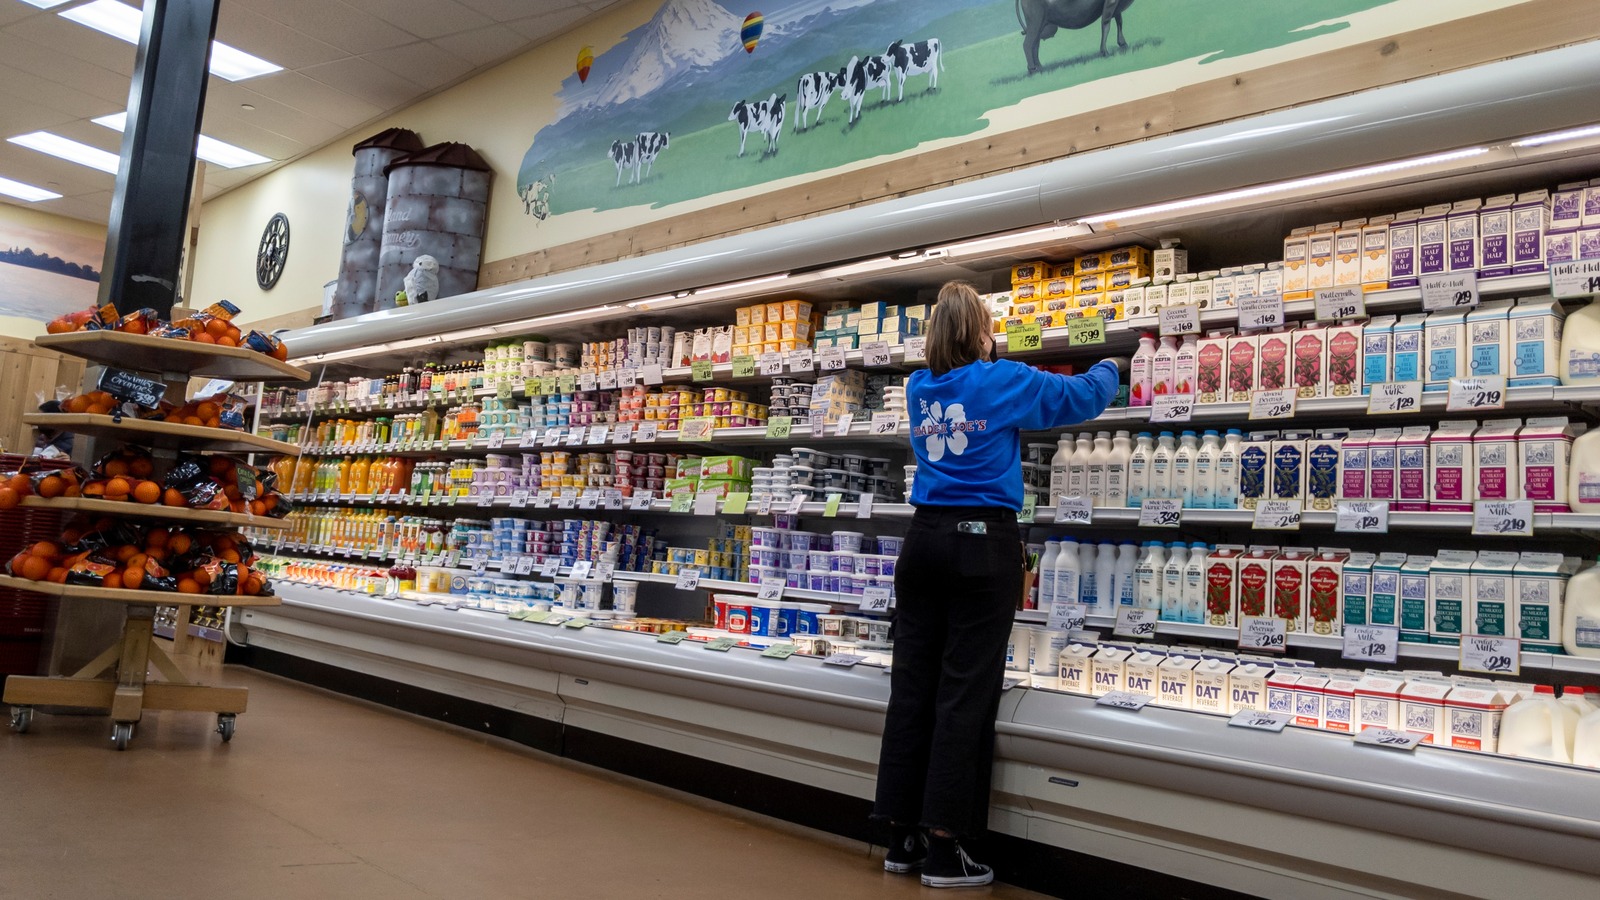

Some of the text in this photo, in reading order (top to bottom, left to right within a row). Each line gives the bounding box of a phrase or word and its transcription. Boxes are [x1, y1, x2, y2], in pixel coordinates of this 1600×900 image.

[1554, 263, 1575, 276] Half
[1583, 261, 1600, 273] Hal
[1320, 290, 1357, 300] Buttermilk
[951, 420, 987, 432] JOE'S
[1489, 508, 1511, 516] Milk
[1061, 667, 1083, 680] OAT
[1096, 673, 1118, 684] OAT
[1061, 680, 1080, 688] BEVERAGE
[1129, 676, 1151, 689] OAT
[1162, 681, 1186, 694] OAT
[1196, 685, 1221, 699] OAT
[1233, 689, 1259, 703] OAT
[1162, 694, 1183, 703] BEVERAGE
[1197, 698, 1218, 707] BEVERAGE
